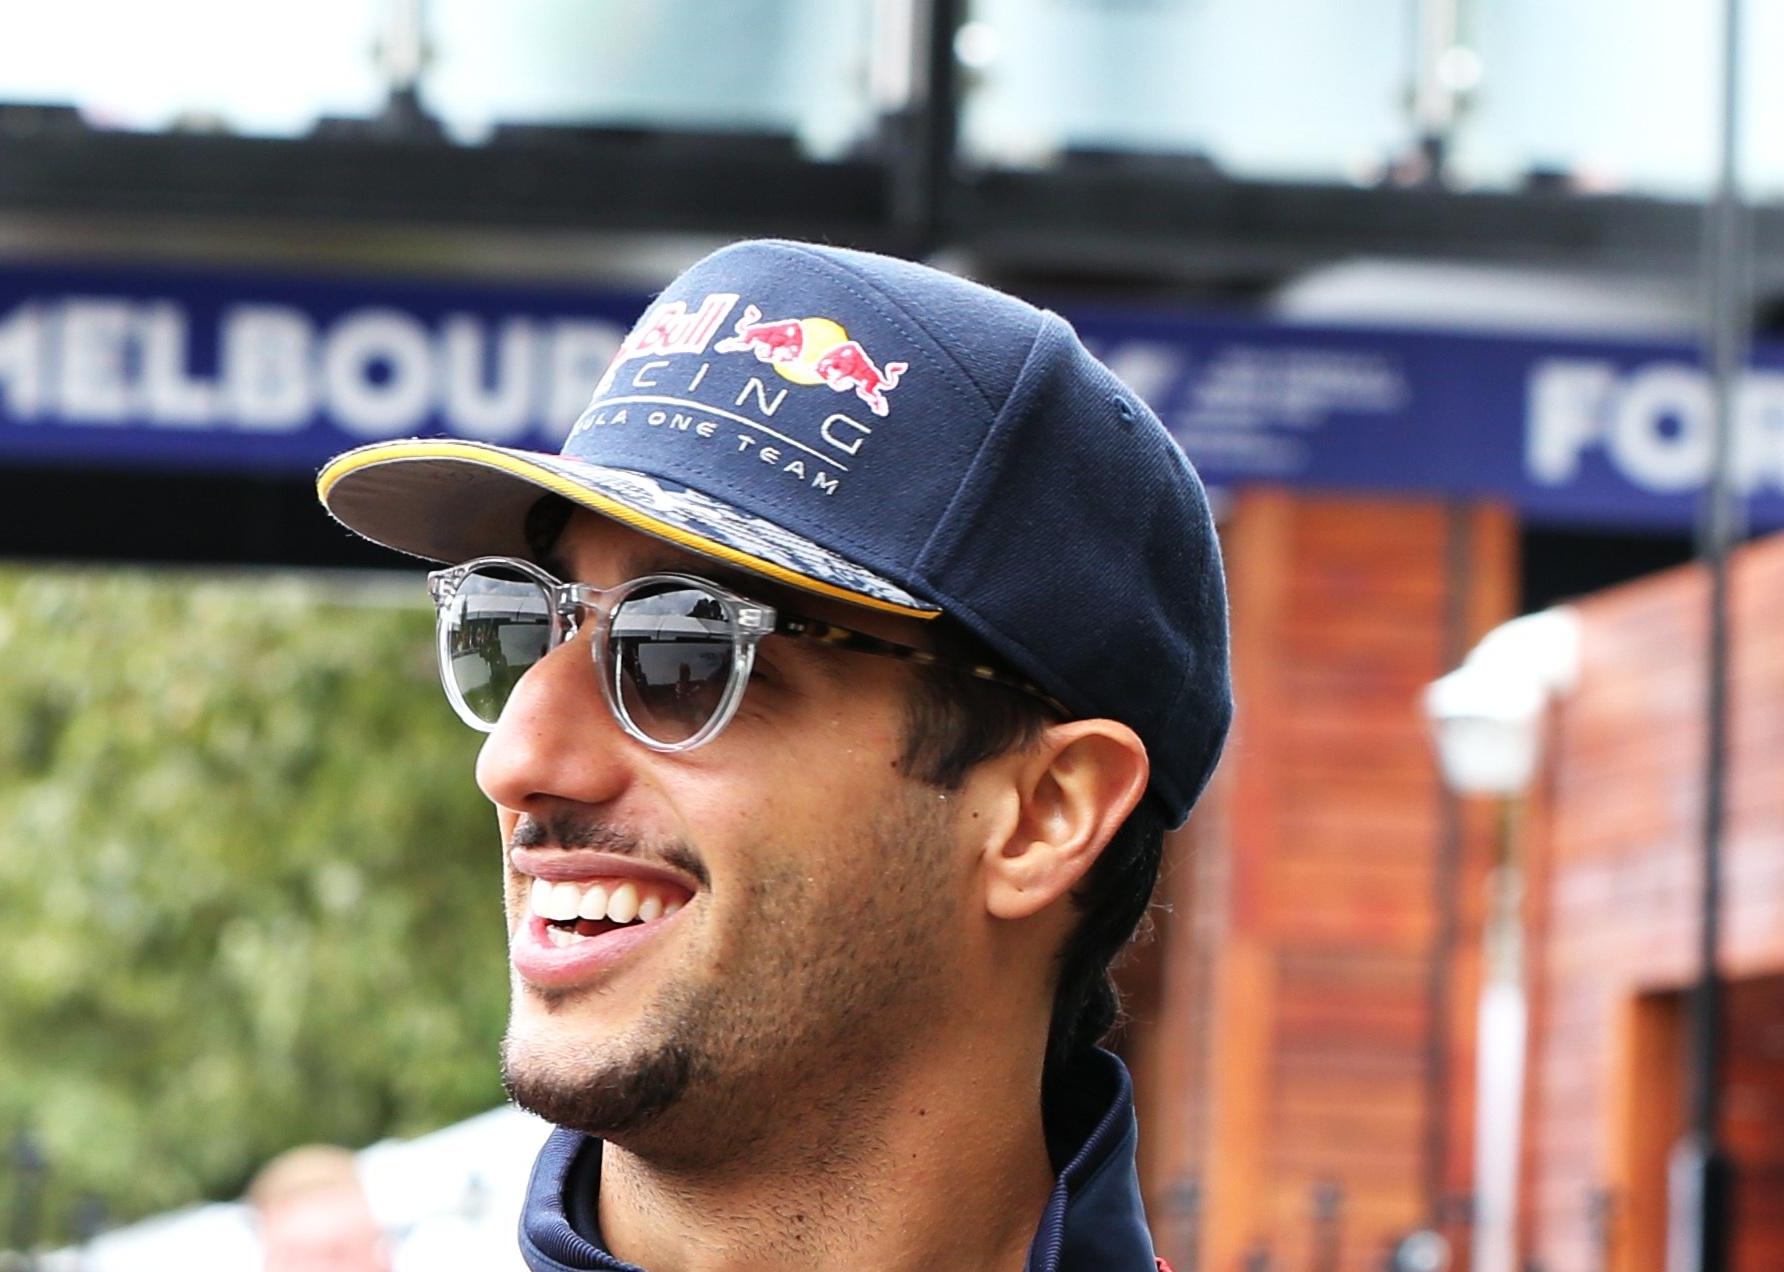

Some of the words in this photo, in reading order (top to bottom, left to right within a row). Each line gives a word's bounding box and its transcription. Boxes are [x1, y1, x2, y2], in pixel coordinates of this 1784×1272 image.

[592, 358, 872, 455] CING
[647, 411, 718, 438] ONE
[736, 434, 840, 495] TEAM
